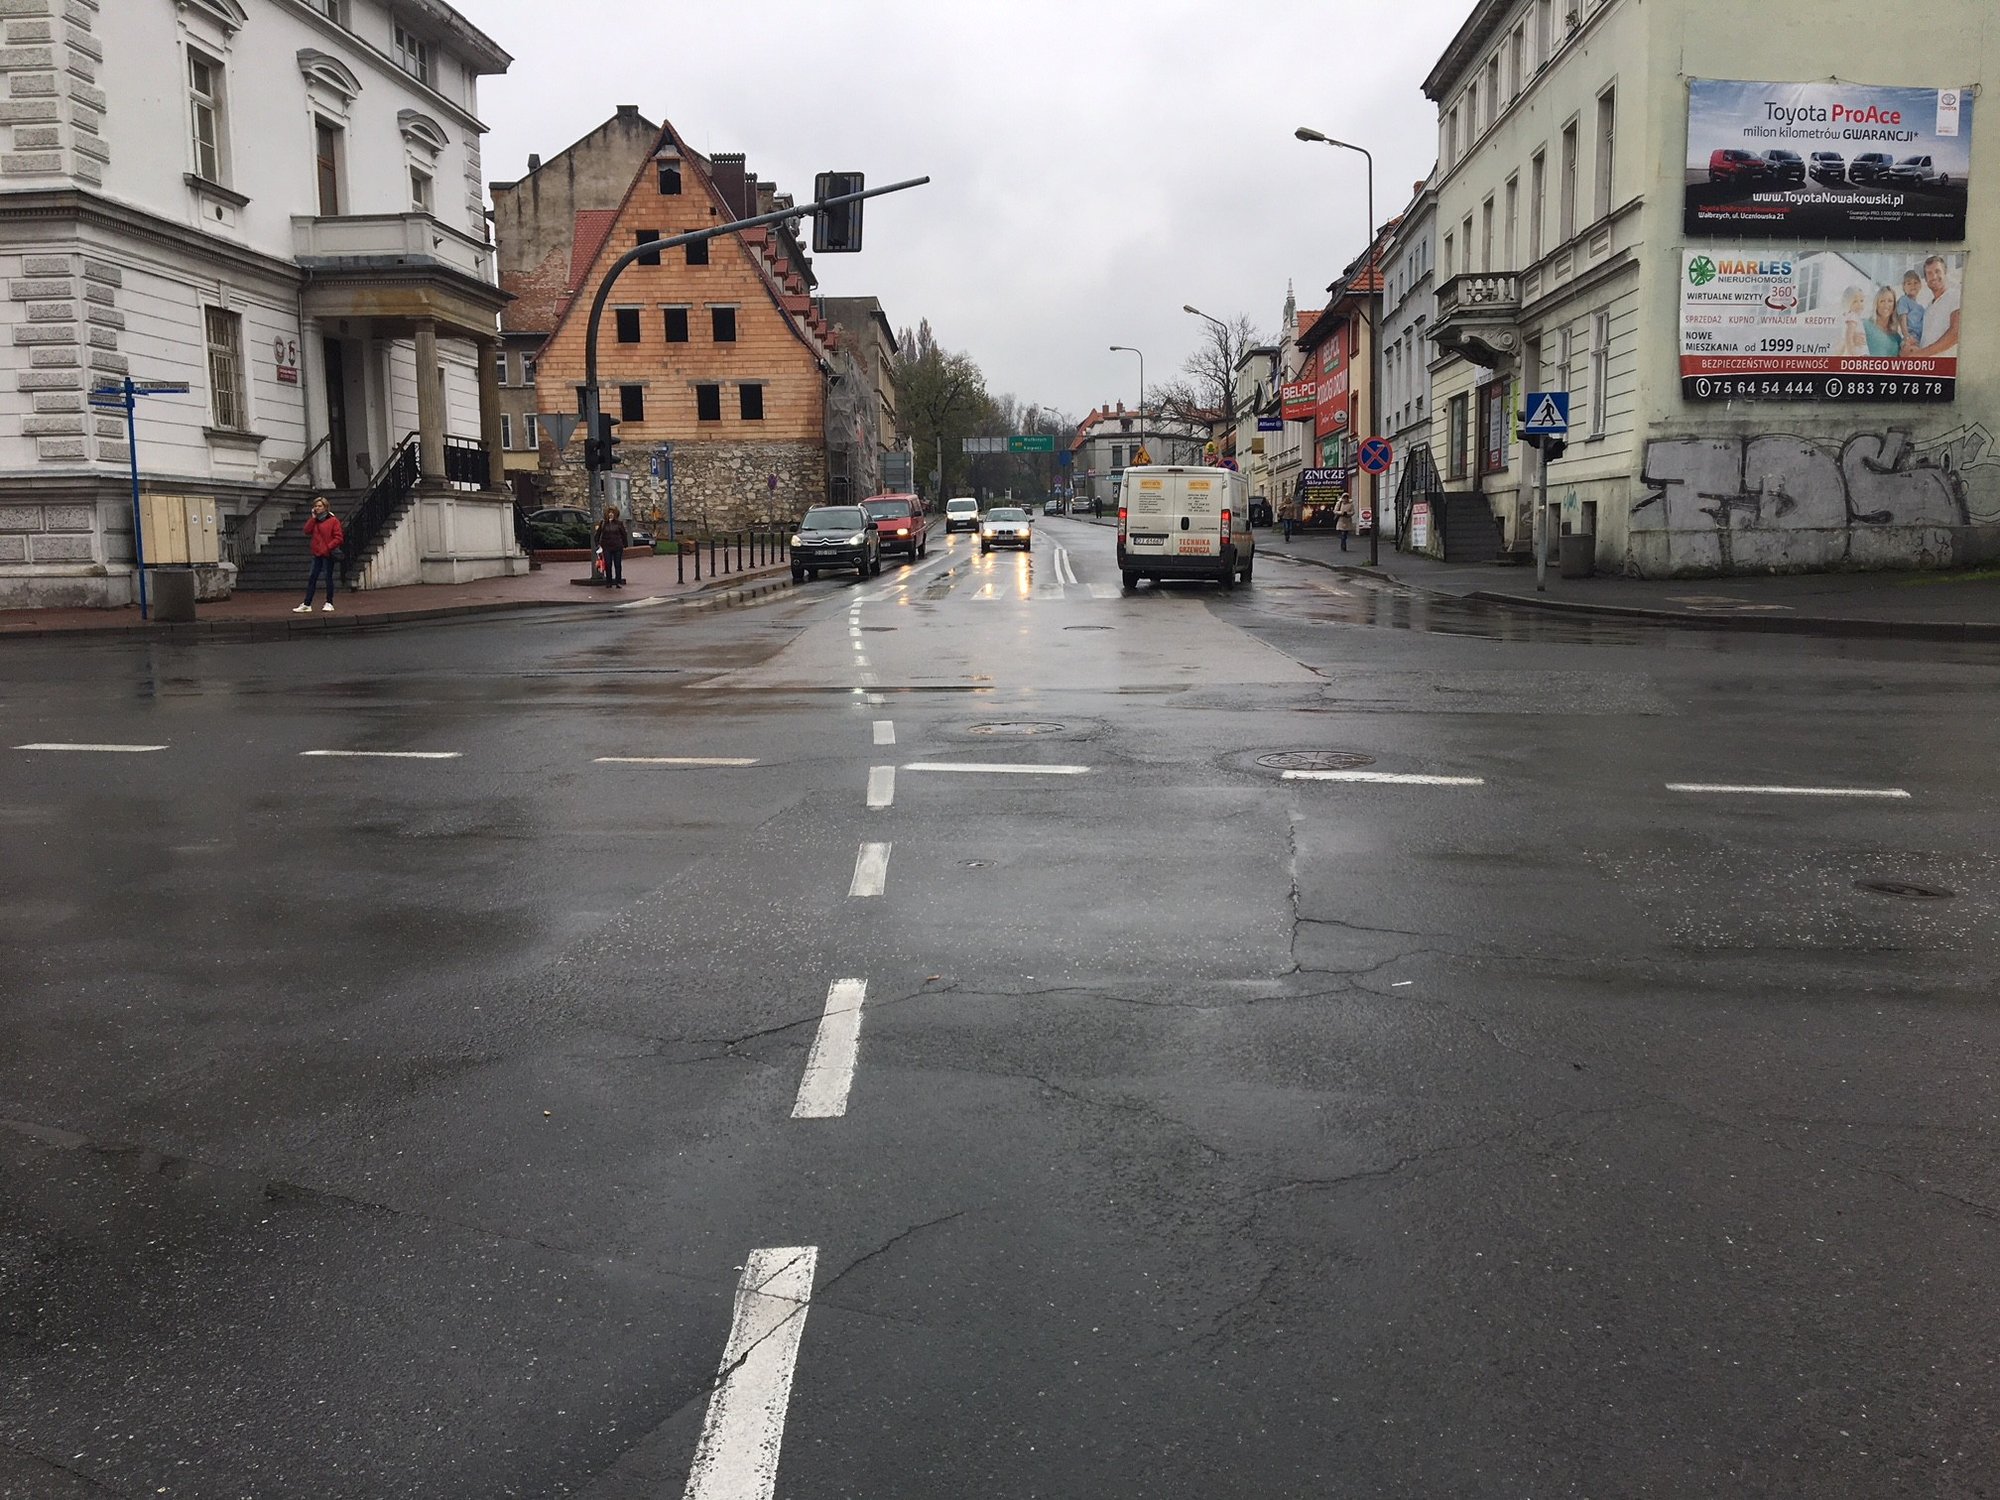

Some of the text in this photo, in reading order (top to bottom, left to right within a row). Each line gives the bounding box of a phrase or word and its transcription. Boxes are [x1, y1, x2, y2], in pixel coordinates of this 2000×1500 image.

[1764, 102, 1901, 125] Toyota ProAce
[1743, 126, 1777, 138] milion
[1779, 127, 1840, 139] kilometrów
[1752, 192, 1904, 207] www.ToyotaNowakowski.pl
[1718, 260, 1792, 275] MARLES
[1718, 275, 1792, 284] NIERUCHOMOŚCI
[1687, 292, 1733, 300] WIRTUALNE
[1734, 293, 1763, 301] WIZYTY
[1685, 315, 1837, 325] SPRZEDAŻ KUPNO WYNAJEM KREDYTY
[1685, 331, 1712, 340] NOWE
[1685, 342, 1738, 351] MIESZKANIA
[1744, 343, 1756, 352] od
[1760, 338, 1794, 352] 1999
[1702, 358, 1936, 371] BEZPIECZEŃSTWO I PEWNOŚĆ DOBREGO WYBORU
[1282, 382, 1316, 400] BEL-PO
[1713, 382, 1942, 394] 75 64 54 444 883 79 78 78
[1305, 469, 1345, 480] ZNICZE
[1179, 538, 1210, 546] TECHNIKA
[1179, 546, 1210, 554] GRZEWCZA
